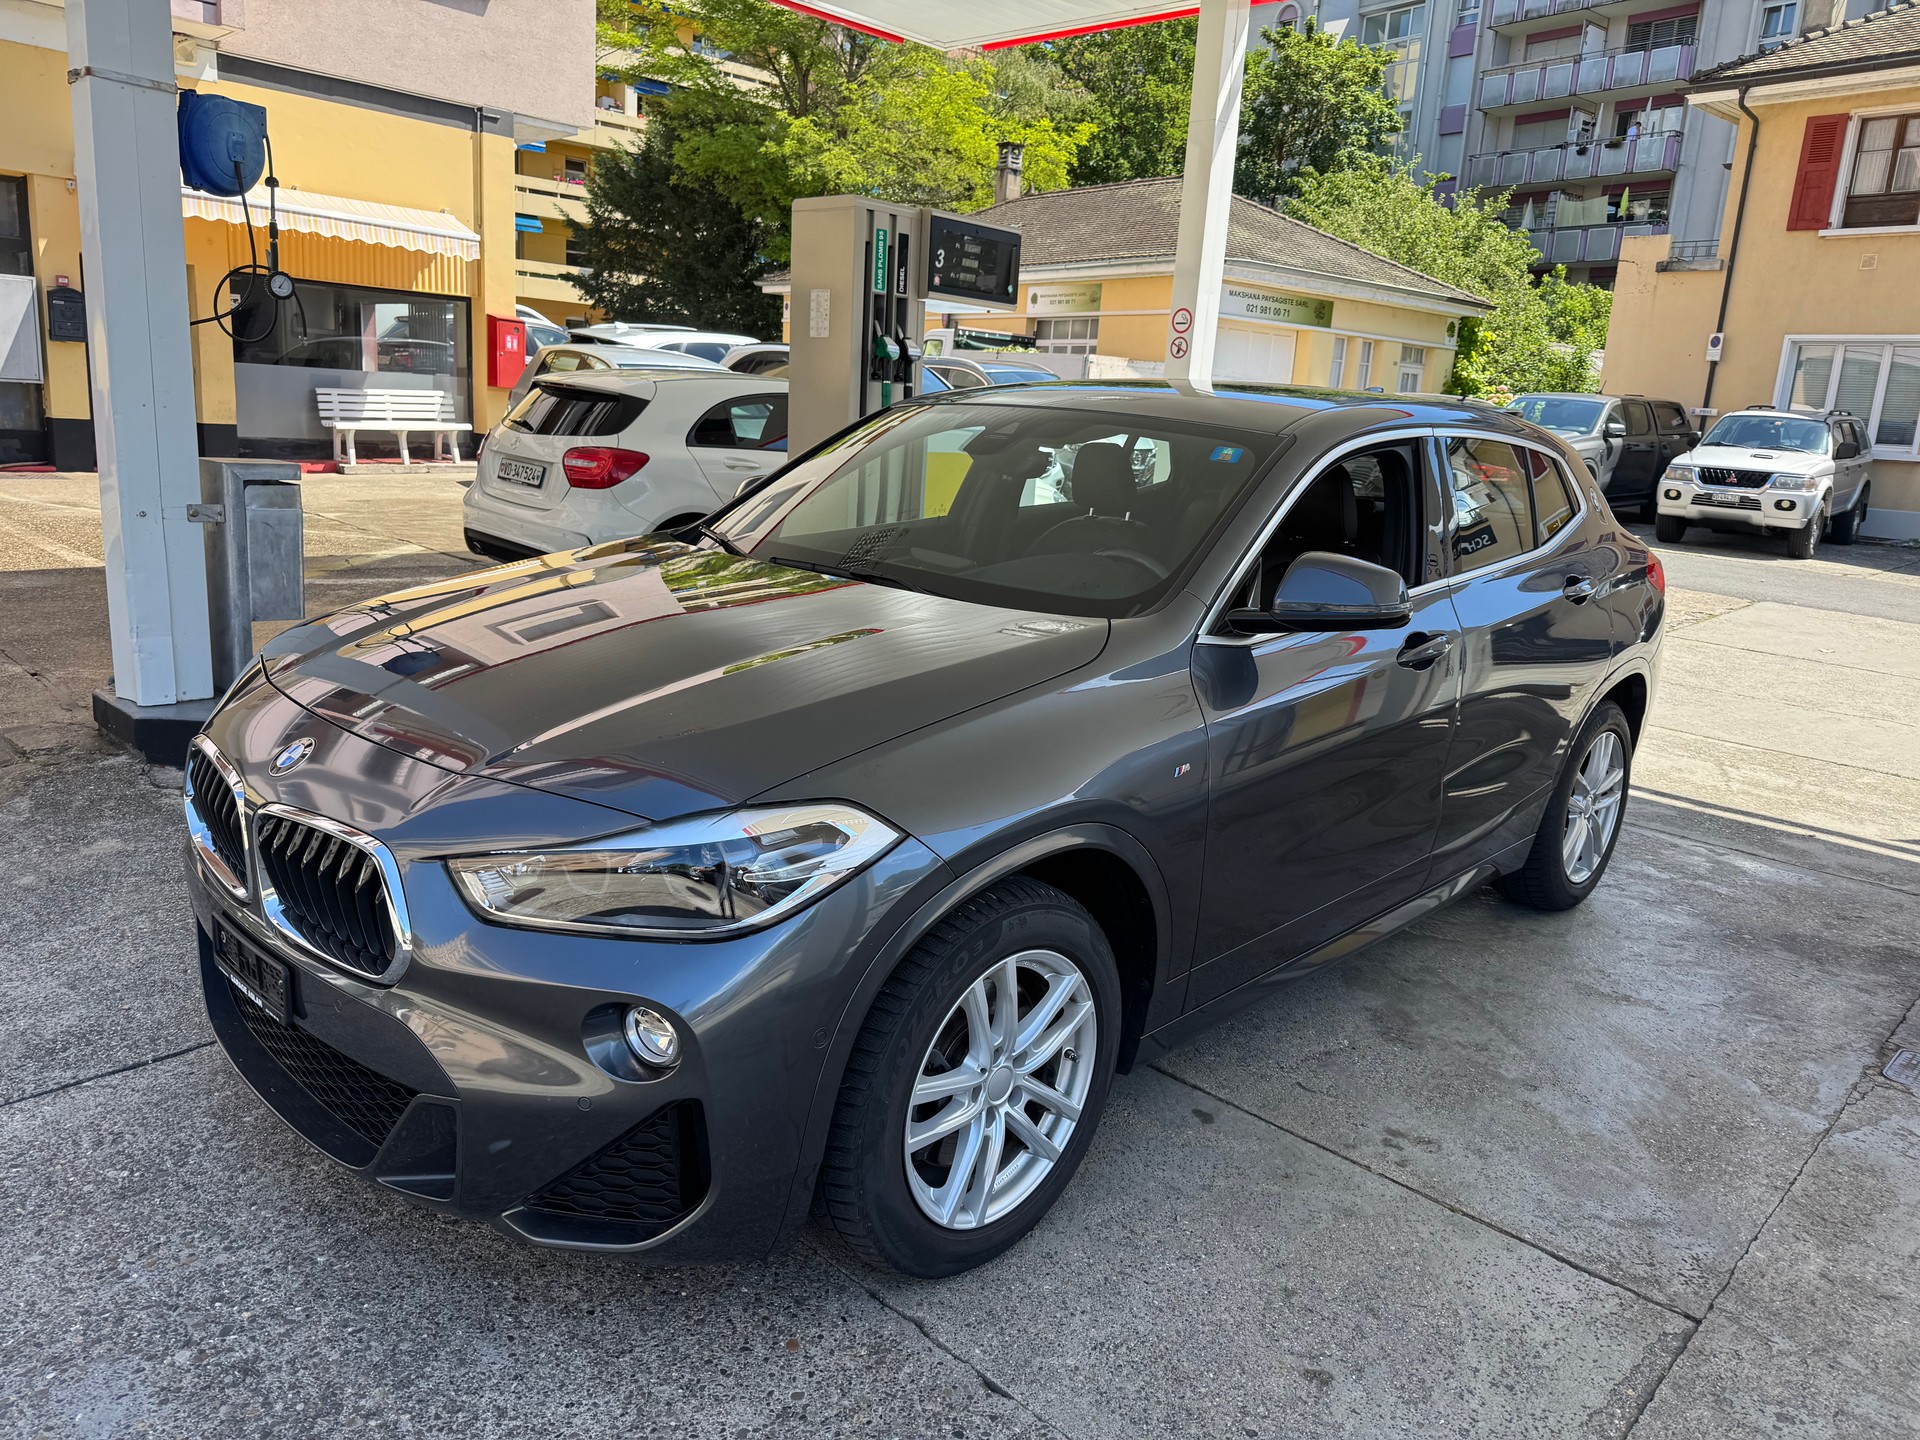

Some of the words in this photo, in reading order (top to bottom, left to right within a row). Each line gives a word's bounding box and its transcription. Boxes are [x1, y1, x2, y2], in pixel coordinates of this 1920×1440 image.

[879, 231, 884, 240] 95
[935, 249, 945, 268] 3
[1229, 289, 1260, 300] MAKSHANA
[1261, 295, 1294, 306] PAYSAGISTE
[1246, 304, 1258, 313] 021
[1260, 306, 1271, 315] 981
[1273, 308, 1281, 316] 00
[1283, 309, 1290, 317] 71
